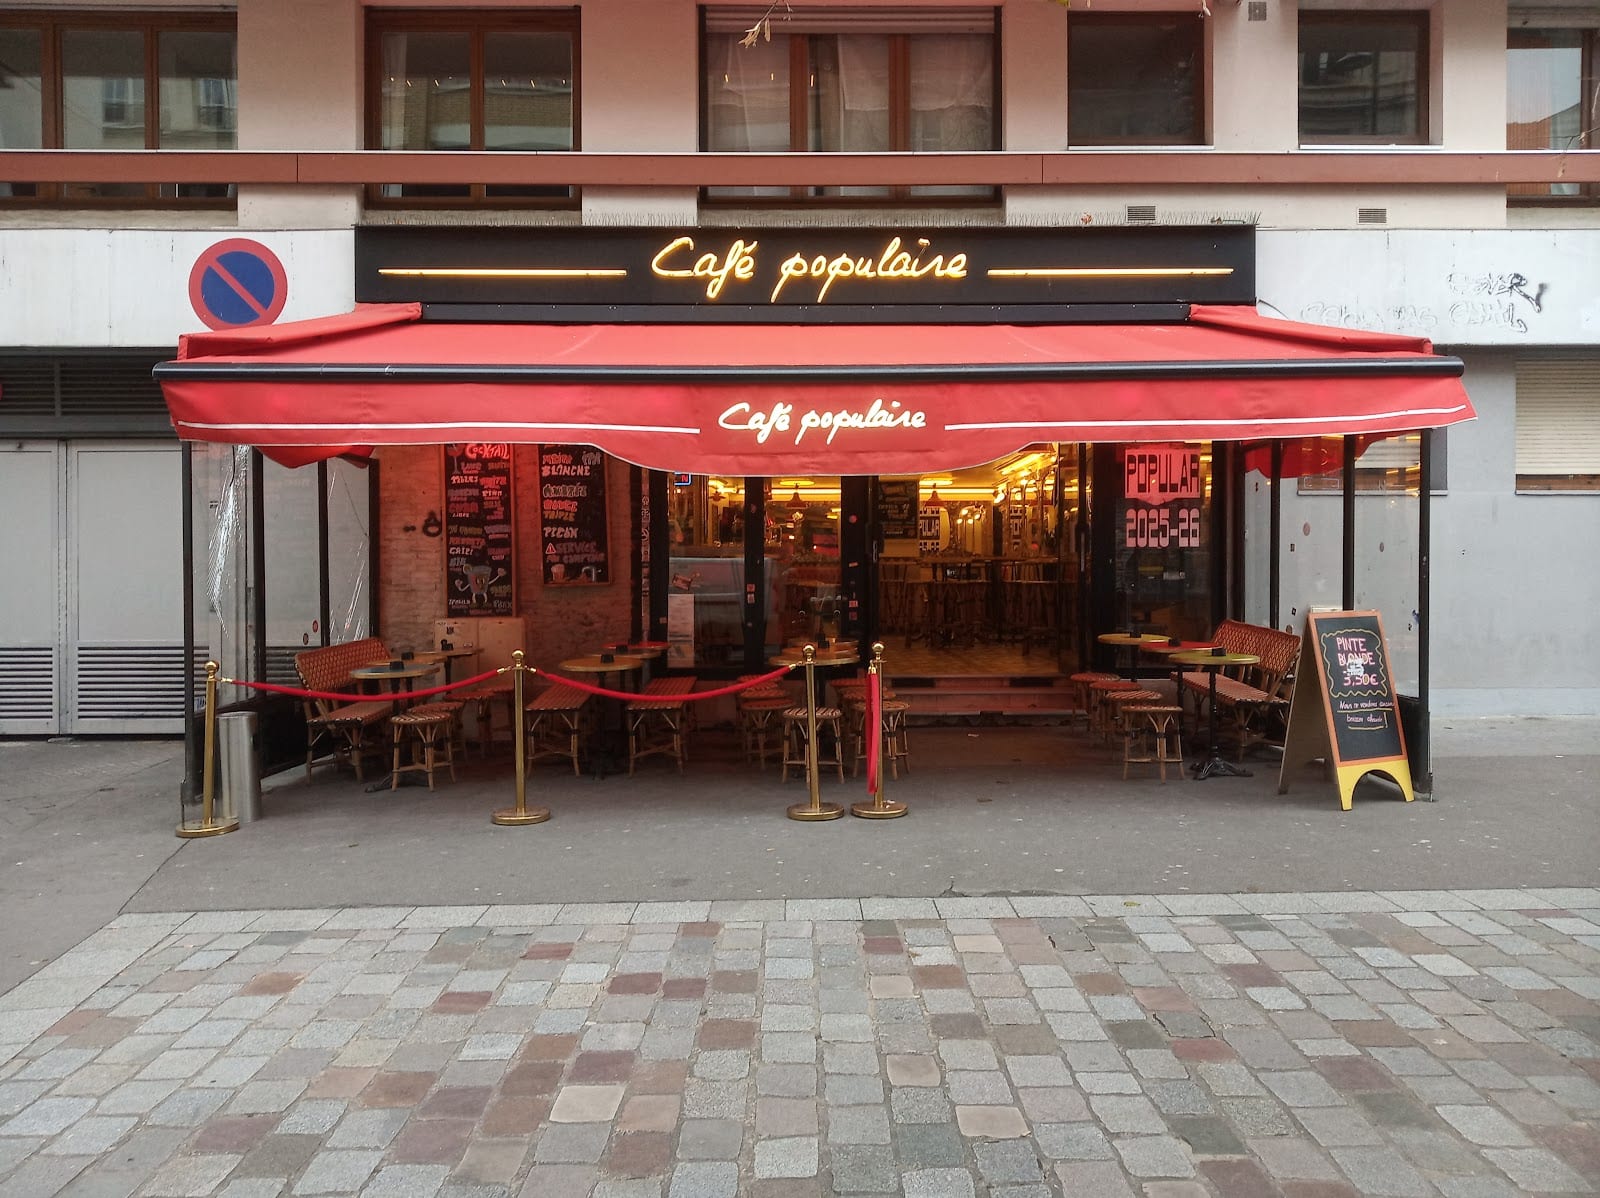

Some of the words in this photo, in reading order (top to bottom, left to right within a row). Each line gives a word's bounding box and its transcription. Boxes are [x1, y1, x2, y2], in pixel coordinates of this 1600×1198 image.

[651, 236, 758, 299] Café
[770, 236, 968, 303] populaire
[717, 402, 793, 445] Café
[794, 399, 927, 445] populaire
[1126, 453, 1200, 493] POPULAR
[1126, 508, 1200, 548] 2025-26
[1336, 637, 1367, 652] PINTE
